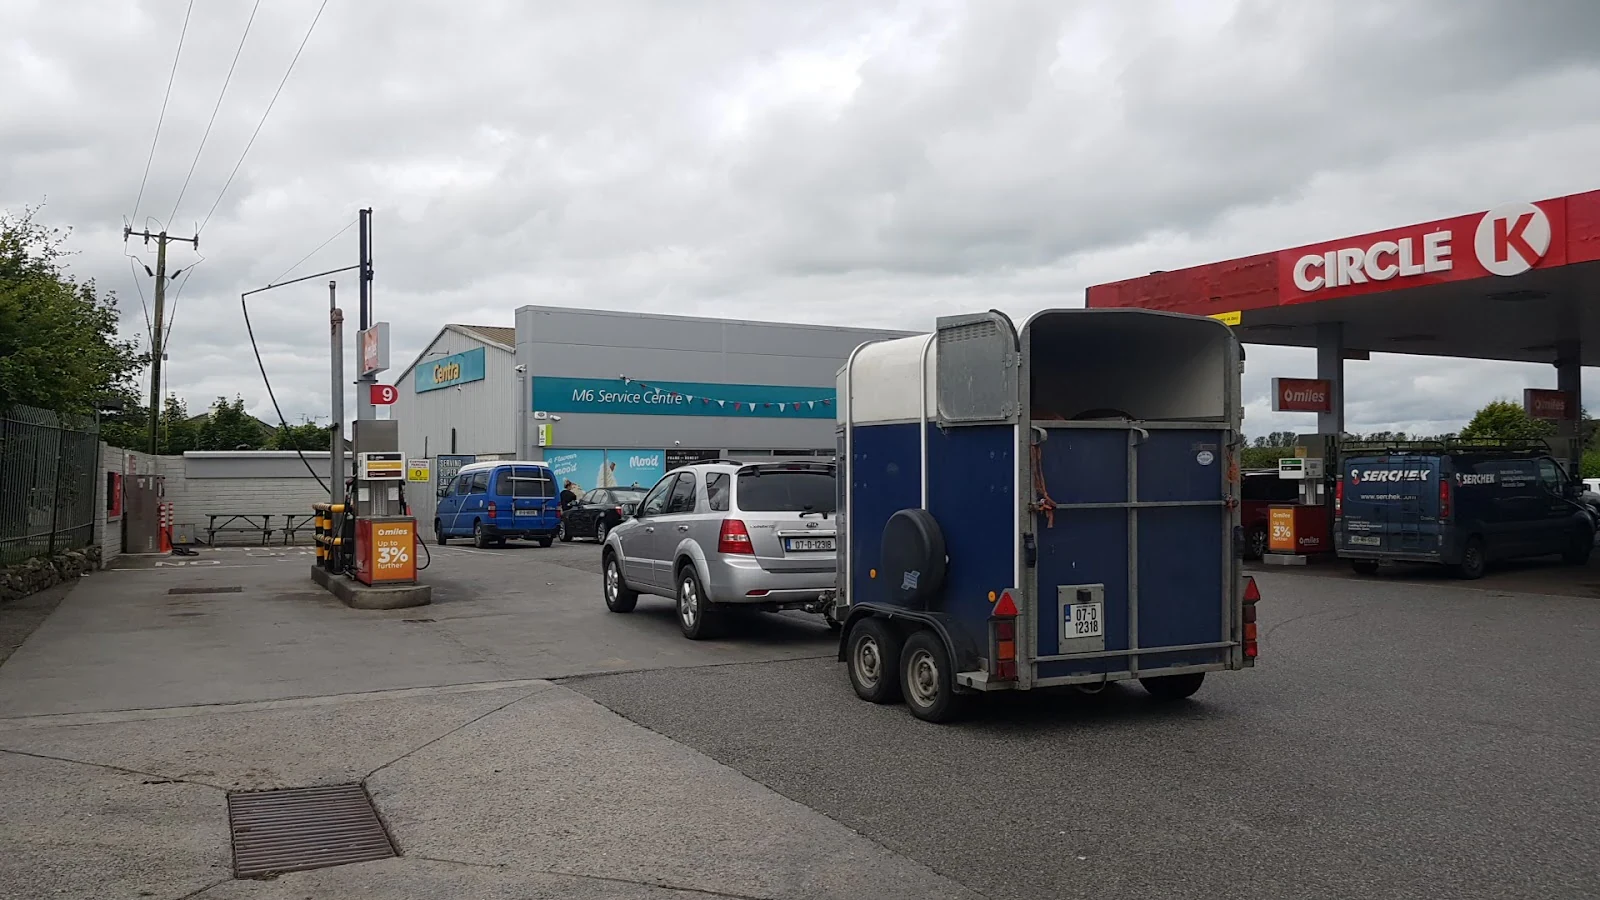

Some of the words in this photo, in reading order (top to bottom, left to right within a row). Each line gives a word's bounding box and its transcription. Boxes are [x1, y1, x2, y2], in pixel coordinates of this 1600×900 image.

[1293, 230, 1453, 292] CIRCLE
[1493, 211, 1544, 269] K
[434, 362, 460, 384] Centra
[382, 387, 393, 402] 9
[572, 389, 594, 402] M6
[597, 390, 641, 404] Service
[643, 391, 683, 405] Centre
[1294, 389, 1325, 402] miles
[1361, 470, 1430, 482] SERCHEK
[1463, 474, 1495, 484] SERCHEK
[385, 528, 408, 536] miles
[1273, 525, 1291, 538] 3%
[795, 541, 831, 549] 07-D-12318
[377, 546, 409, 564] 3%
[1076, 608, 1097, 621] 07-D
[1075, 620, 1098, 634] 12318
